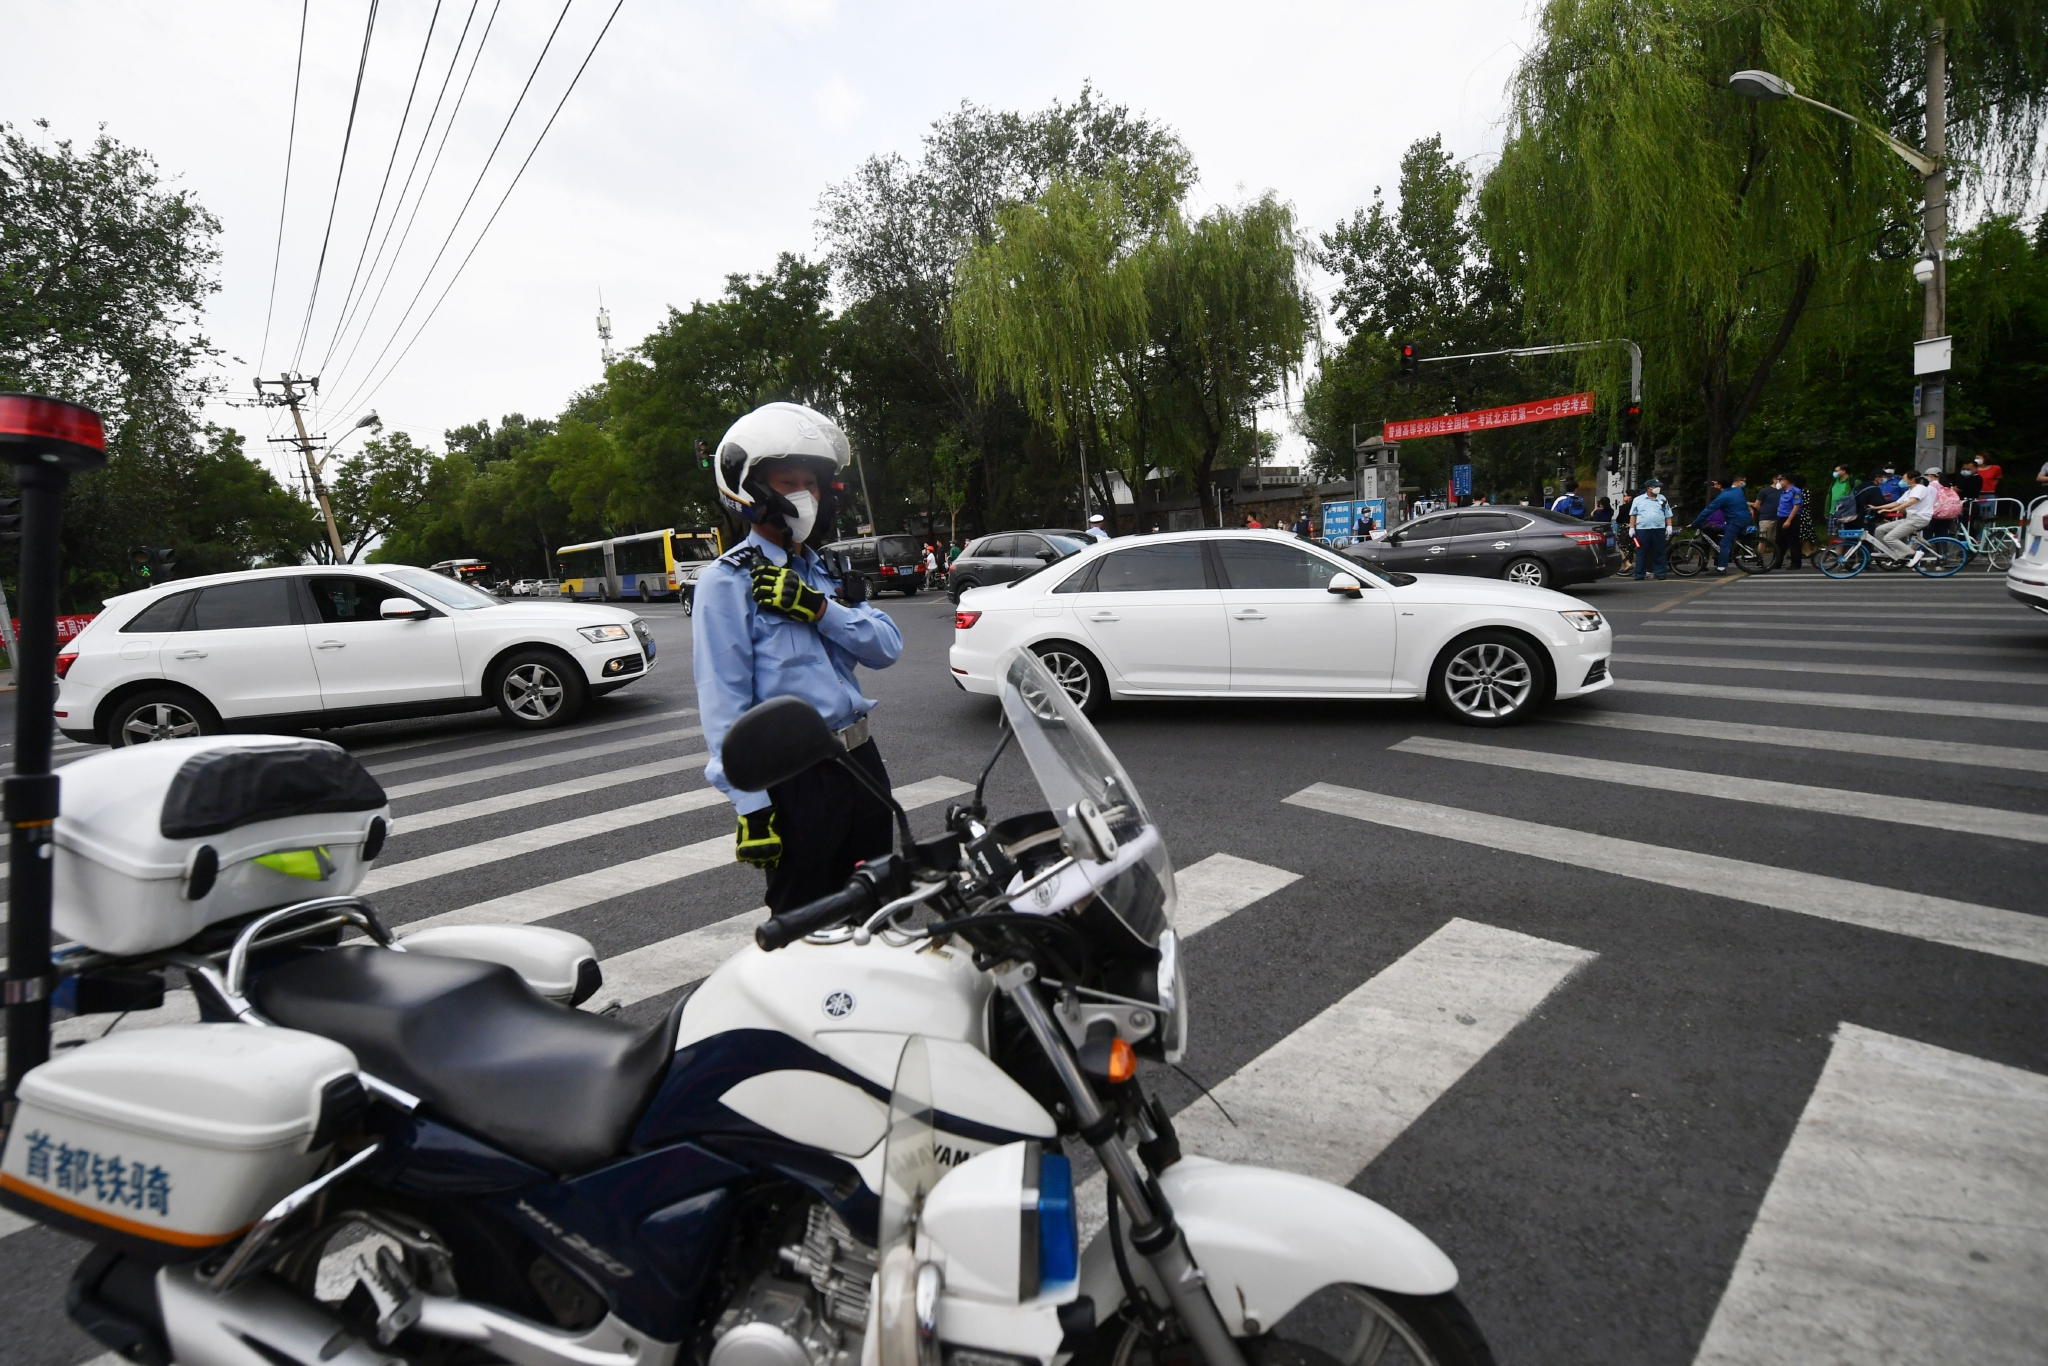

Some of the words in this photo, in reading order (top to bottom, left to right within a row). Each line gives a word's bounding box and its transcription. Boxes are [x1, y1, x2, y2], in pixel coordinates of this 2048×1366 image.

[56, 618, 94, 637] 点周边
[933, 1145, 978, 1168] YAM
[25, 1129, 171, 1217] 首都铁骑
